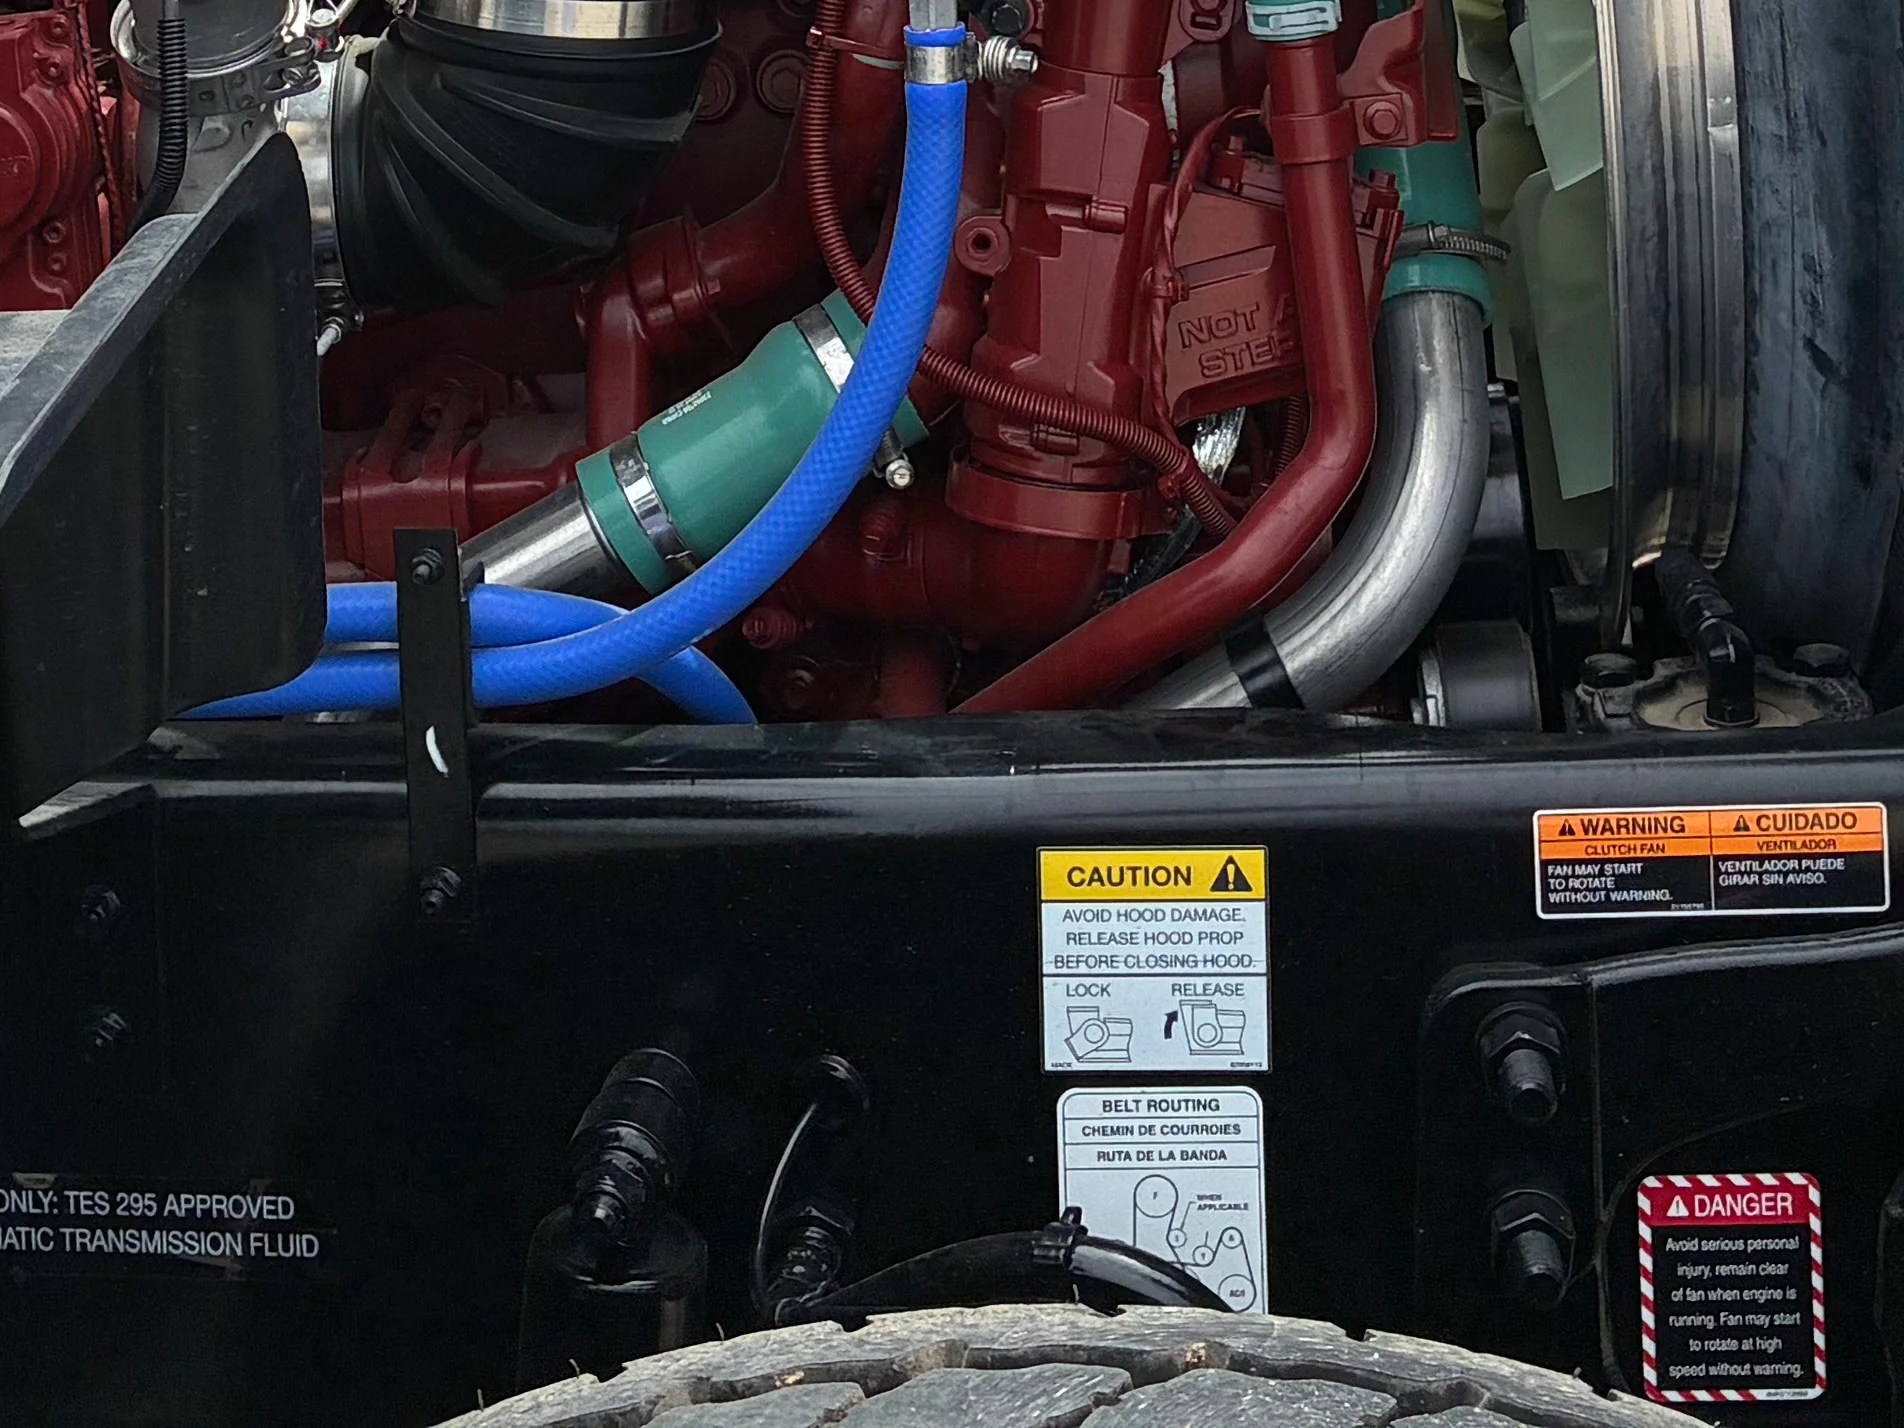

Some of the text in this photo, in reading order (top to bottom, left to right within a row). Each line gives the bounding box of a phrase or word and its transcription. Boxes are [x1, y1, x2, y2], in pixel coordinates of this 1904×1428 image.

[1178, 301, 1260, 349] NOT
[1580, 816, 1686, 836] WARNING
[1756, 811, 1857, 832] CUIDADO
[1584, 843, 1665, 856] CLUTCH FAN
[1757, 838, 1837, 851] VENTILADOR
[1548, 863, 1643, 876] FAN MAY START
[1718, 858, 1845, 872] VENTILADOR PUEDE
[1067, 866, 1191, 887] CAUTION
[1548, 877, 1615, 890] TO ROTATE
[1719, 872, 1826, 886] GIRAR SIN AVISO.
[1548, 889, 1673, 903] WITHOUT WARNING.
[1062, 908, 1246, 923] AVOID HOOD DAMAGE.
[1066, 931, 1244, 946] RELEASE HOOD PROP
[1054, 954, 1258, 969] BEFORE CLOSING HOOD.
[1066, 983, 1111, 997] LOCK
[1171, 983, 1245, 997] RELEASE
[1102, 1098, 1220, 1113] BELT ROUTING
[1082, 1123, 1241, 1137] CHEMIN DE COURROIES
[1097, 1149, 1227, 1162] RUTA DE LA BANDA
[64, 1191, 110, 1216] TES
[116, 1192, 157, 1216] 295
[163, 1193, 294, 1219] APPROVED
[1694, 1192, 1793, 1217] DANGER
[59, 1228, 243, 1256] TRANSMISSION
[250, 1232, 319, 1257] FLUID
[1666, 1236, 1799, 1252] Avoid serious personal
[1677, 1262, 1789, 1279] injury, remain clear
[1686, 1287, 1783, 1302] fan when engine
[1669, 1312, 1800, 1329] running. Fan start
[1704, 1337, 1782, 1353] rotate high
[1669, 1362, 1804, 1379] speed without warning.
